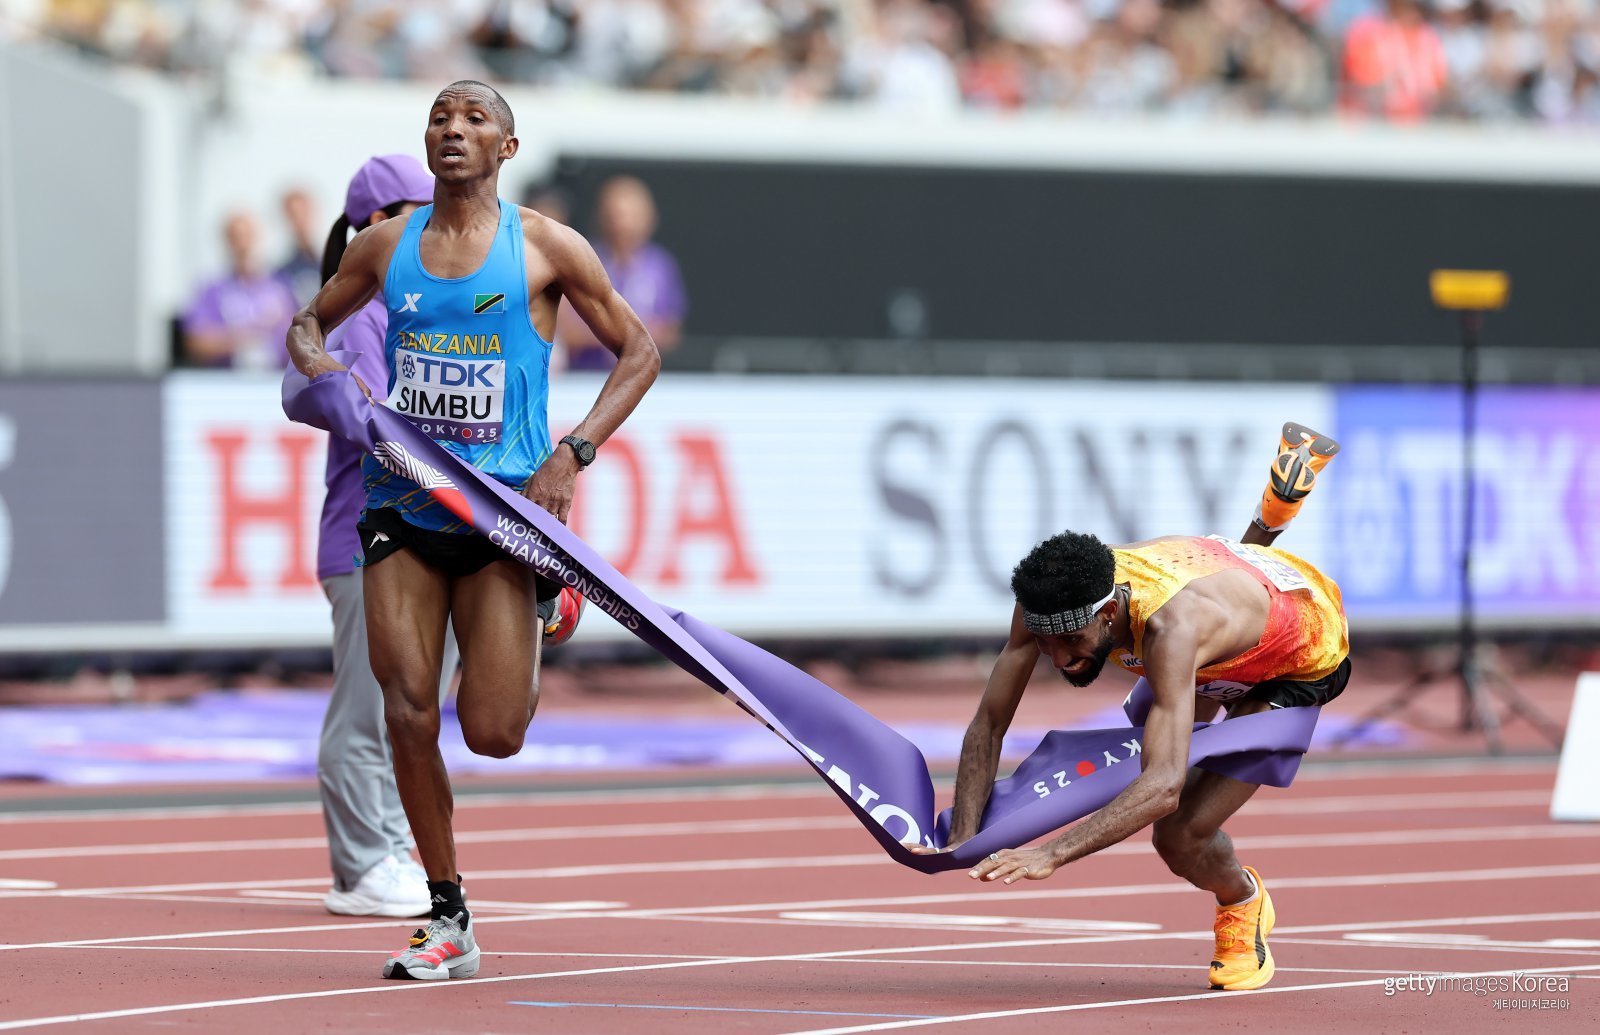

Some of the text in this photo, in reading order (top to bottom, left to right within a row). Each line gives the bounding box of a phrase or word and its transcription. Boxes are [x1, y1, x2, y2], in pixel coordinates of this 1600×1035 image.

[398, 331, 502, 355] TANZANIA
[416, 356, 496, 388] TDK
[396, 386, 492, 420] SIMBU
[868, 416, 1258, 598] SONY
[496, 514, 558, 554] WORLD
[488, 529, 642, 630] CHAMPIONSHIPS
